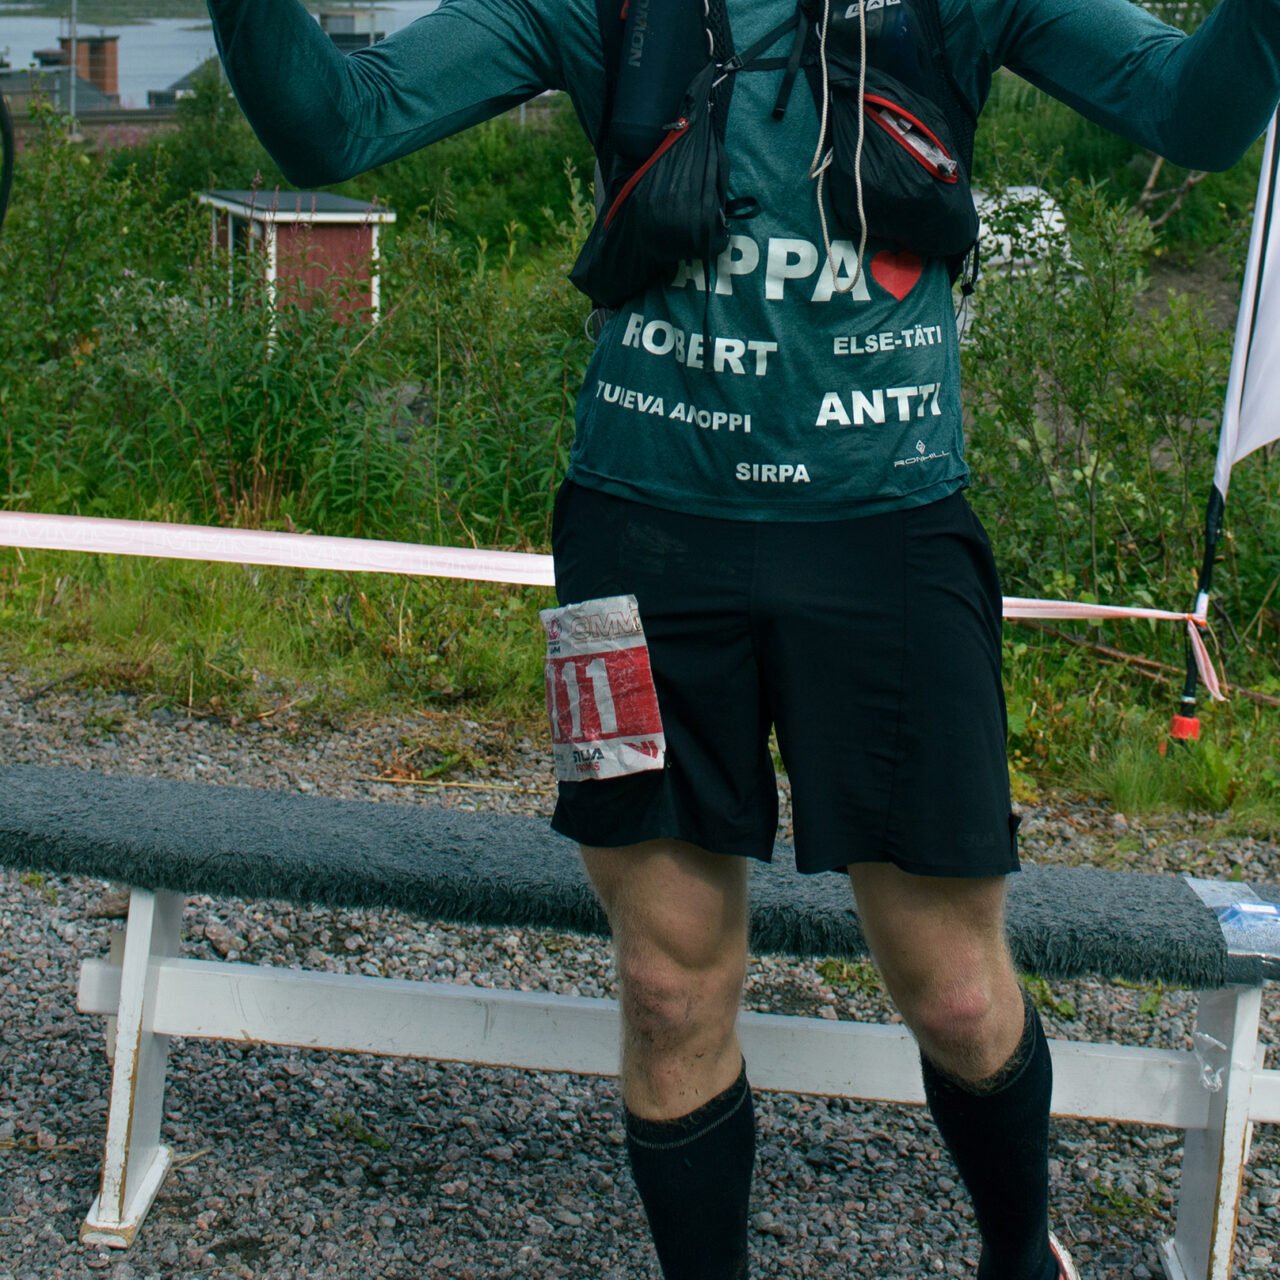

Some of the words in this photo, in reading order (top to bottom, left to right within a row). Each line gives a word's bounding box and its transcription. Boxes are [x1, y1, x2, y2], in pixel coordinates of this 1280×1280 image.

[621, 312, 777, 376] ROBERT
[834, 324, 942, 355] ELSE-TÄTI
[736, 462, 811, 482] SIRPA
